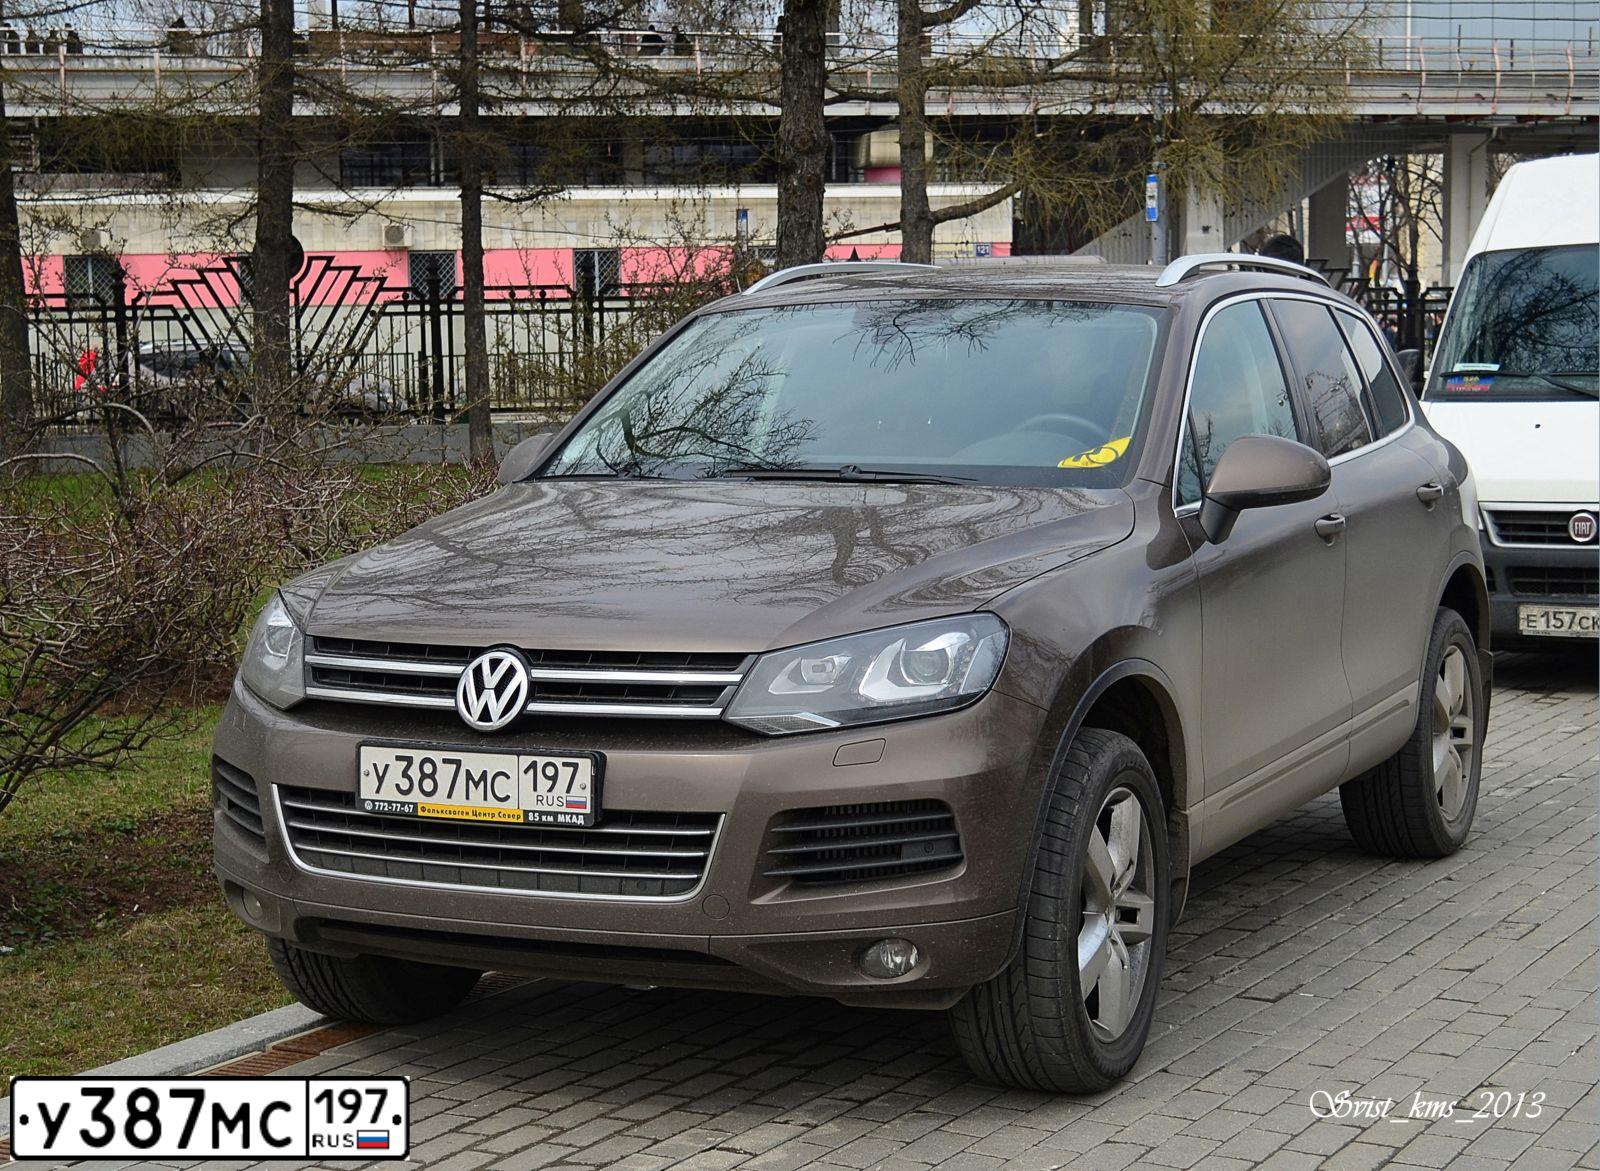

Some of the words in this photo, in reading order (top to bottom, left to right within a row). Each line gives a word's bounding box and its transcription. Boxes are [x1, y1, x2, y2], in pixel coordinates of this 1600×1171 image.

[1574, 521, 1592, 535] FIAT
[523, 760, 580, 795] 197
[536, 794, 565, 808] RUS
[374, 801, 414, 814] 772-77-67
[471, 809, 496, 819] Центр
[497, 811, 521, 821] Север
[528, 812, 540, 822] 85
[541, 814, 554, 822] км
[557, 813, 585, 826] МКАД
